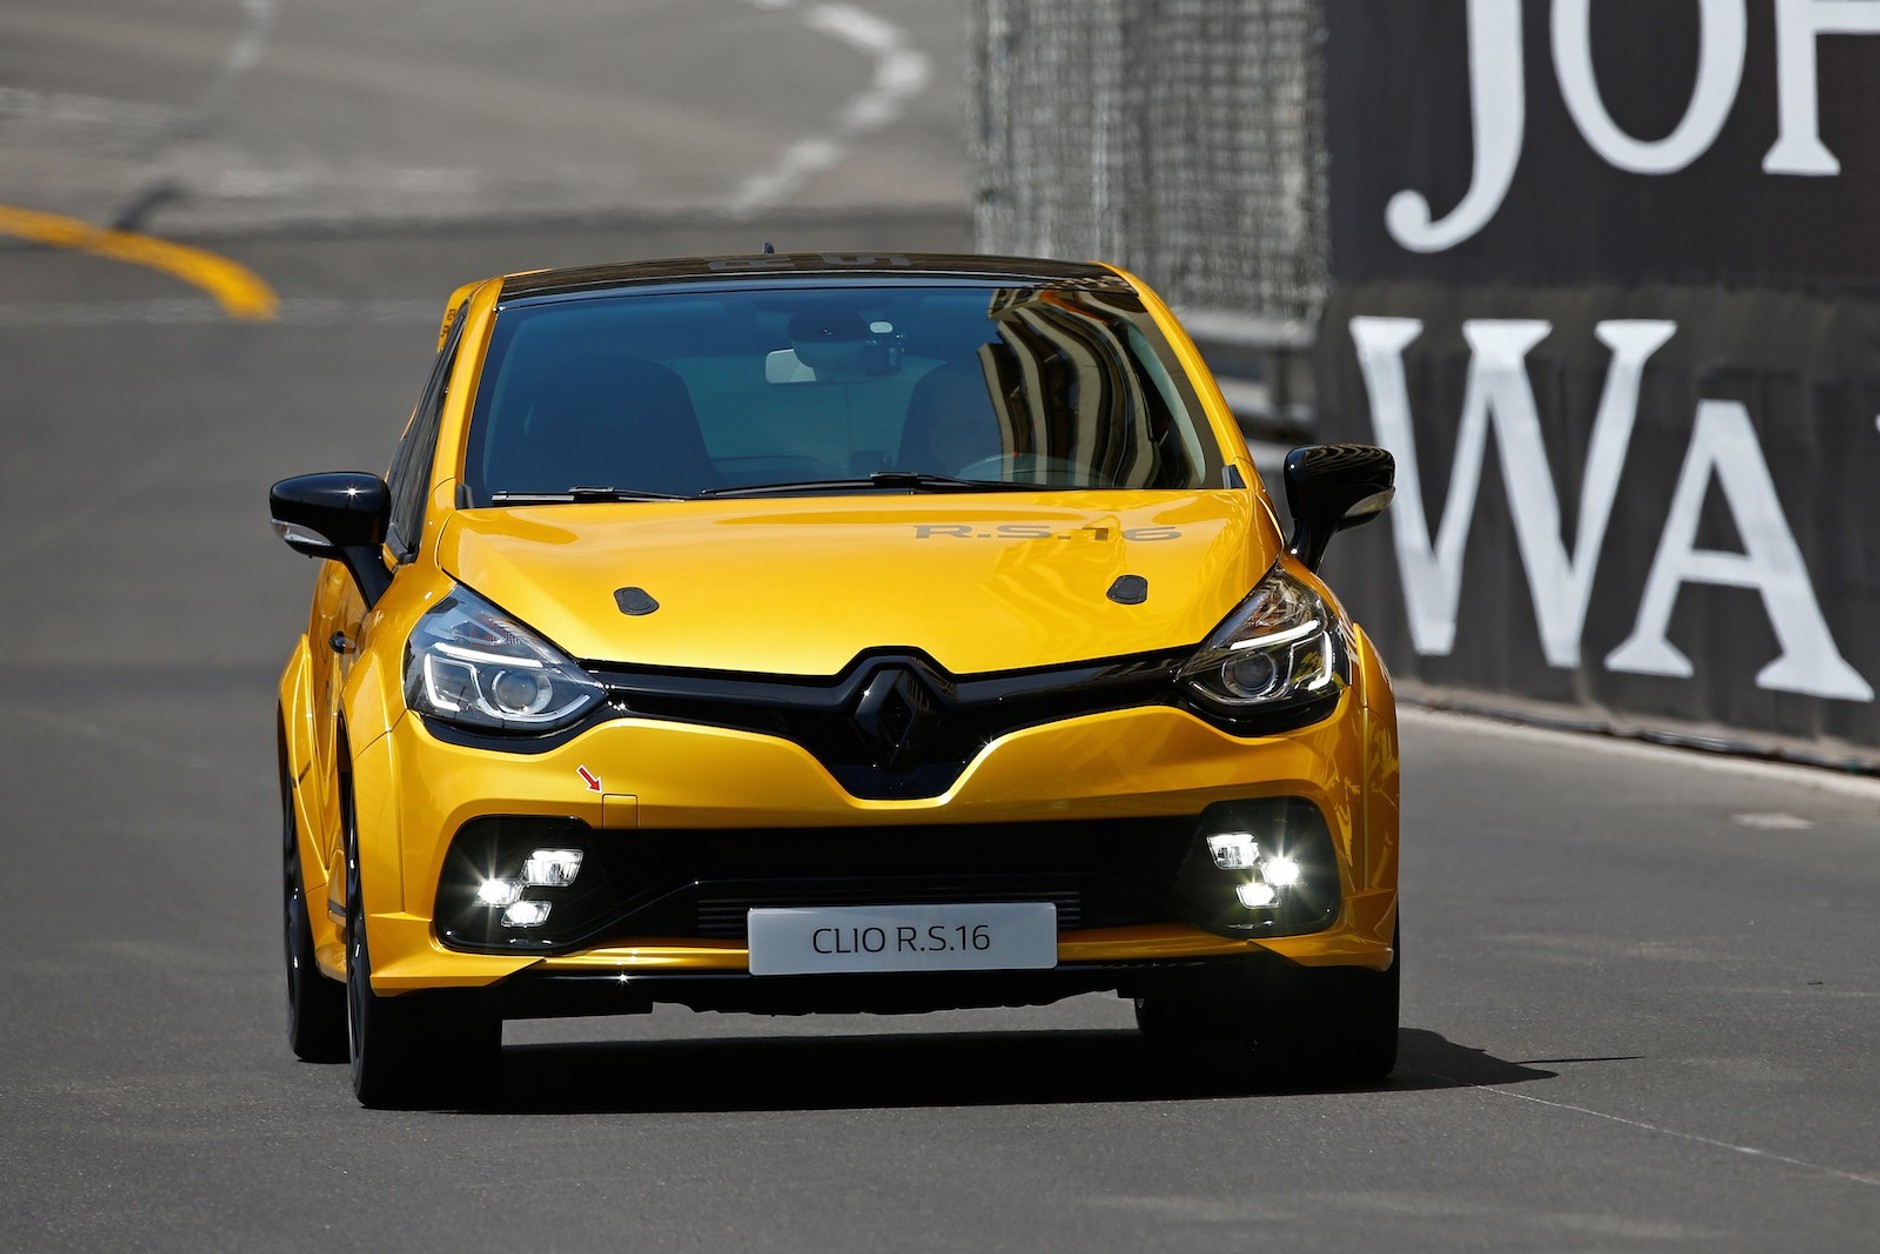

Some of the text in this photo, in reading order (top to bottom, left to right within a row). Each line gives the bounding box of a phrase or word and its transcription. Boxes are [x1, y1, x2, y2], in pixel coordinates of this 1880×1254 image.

[1350, 316, 1880, 701] WA
[913, 524, 1182, 542] R.S.16
[812, 925, 991, 954] CLIO R.S.16
